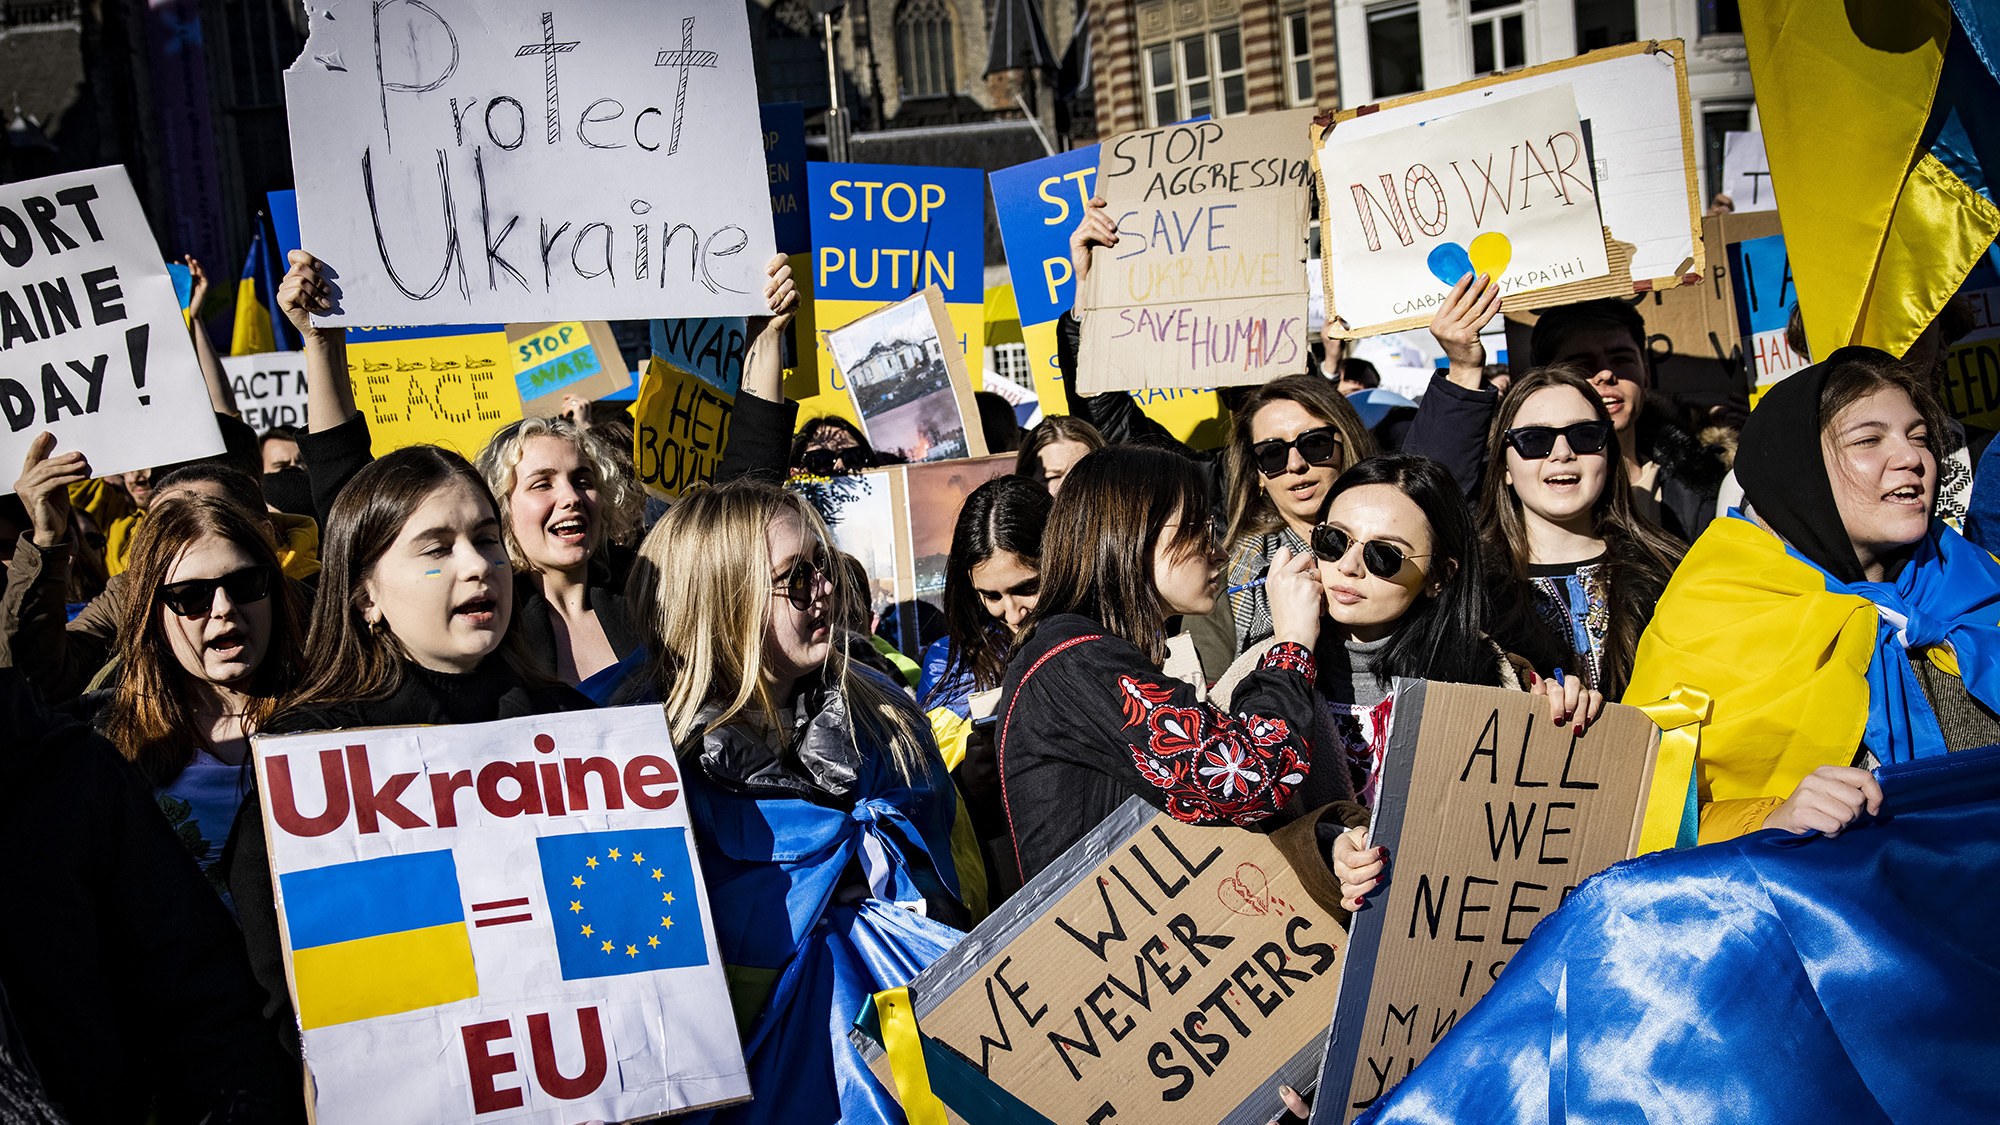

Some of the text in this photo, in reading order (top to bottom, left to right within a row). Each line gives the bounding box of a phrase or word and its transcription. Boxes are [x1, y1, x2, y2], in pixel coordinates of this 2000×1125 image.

[372, 0, 718, 156] Protect
[1108, 122, 1223, 177] STOP
[829, 180, 946, 223] STOP
[1350, 130, 1595, 252] NO WAR
[0, 184, 104, 268] ORT
[362, 145, 752, 305] Ukraine
[1116, 204, 1237, 260] SAVE
[820, 247, 955, 290] PUTIN
[1128, 252, 1283, 302] UKRAINE
[1501, 257, 1586, 293] УКРАЇНІ
[0, 265, 127, 351] AINE
[1111, 308, 1301, 372] SAVE HUMANS
[519, 326, 573, 363] STOP
[530, 351, 594, 388] WAR
[663, 318, 746, 384] WAR
[233, 370, 290, 400] ACT
[350, 371, 501, 424] EACE
[1459, 708, 1600, 790] ALL
[264, 733, 680, 838] Ukraine
[1484, 801, 1577, 865] WE
[1408, 873, 1577, 945] NEE
[930, 824, 1224, 1078] WE WILL
[1046, 913, 1236, 1082] NEVER
[1146, 916, 1337, 1103] SISTERS
[460, 1005, 608, 1116] EU
